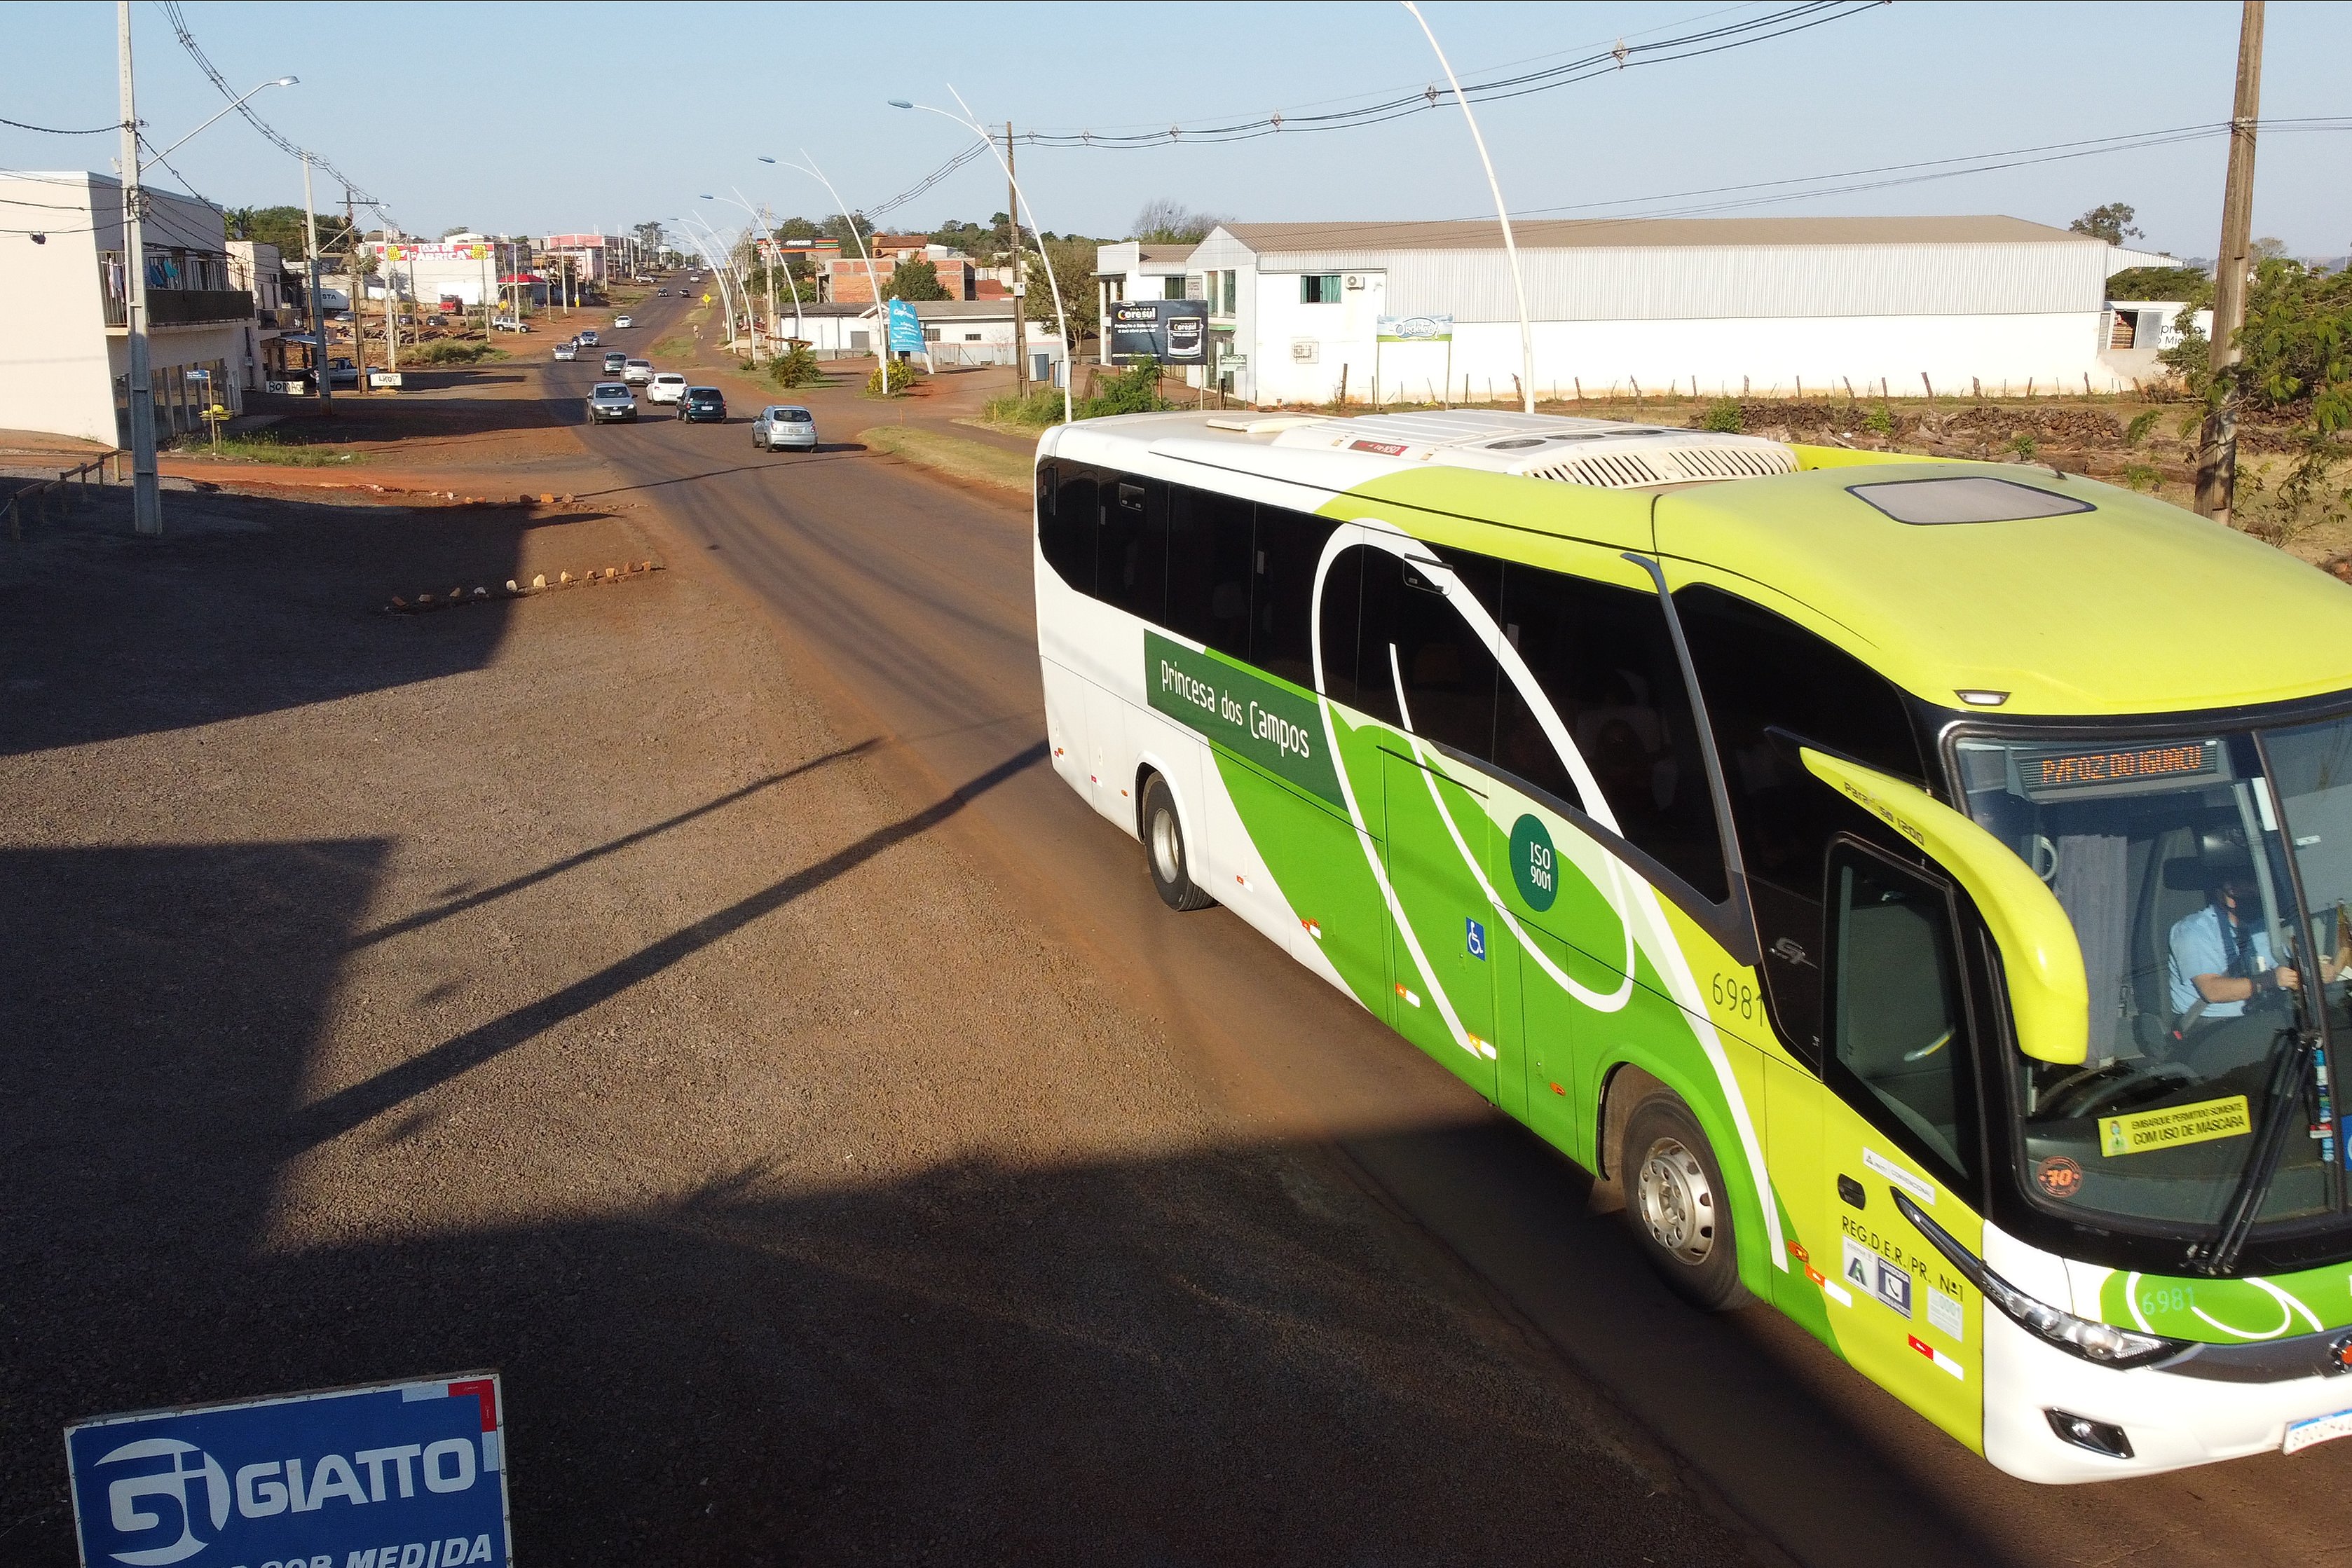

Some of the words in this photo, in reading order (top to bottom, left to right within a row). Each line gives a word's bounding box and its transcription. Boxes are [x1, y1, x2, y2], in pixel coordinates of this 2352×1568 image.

[1118, 308, 1156, 320] Coresul
[1221, 689, 1243, 726] dos
[1250, 701, 1310, 758] Campos
[2110, 752, 2135, 777] DO
[1530, 841, 1551, 870] ISO
[1530, 866, 1552, 892] 9001
[1713, 972, 1763, 1027] 6981
[2131, 1114, 2170, 1130] EMBARQUE
[2210, 1102, 2243, 1116] SOMENTE
[2133, 1129, 2158, 1146] COM
[2159, 1125, 2180, 1140] USO
[2182, 1123, 2196, 1136] DE
[2142, 1286, 2196, 1315] 6981
[235, 1438, 476, 1519] GIATTO
[348, 1534, 492, 1568] MEDIDA
